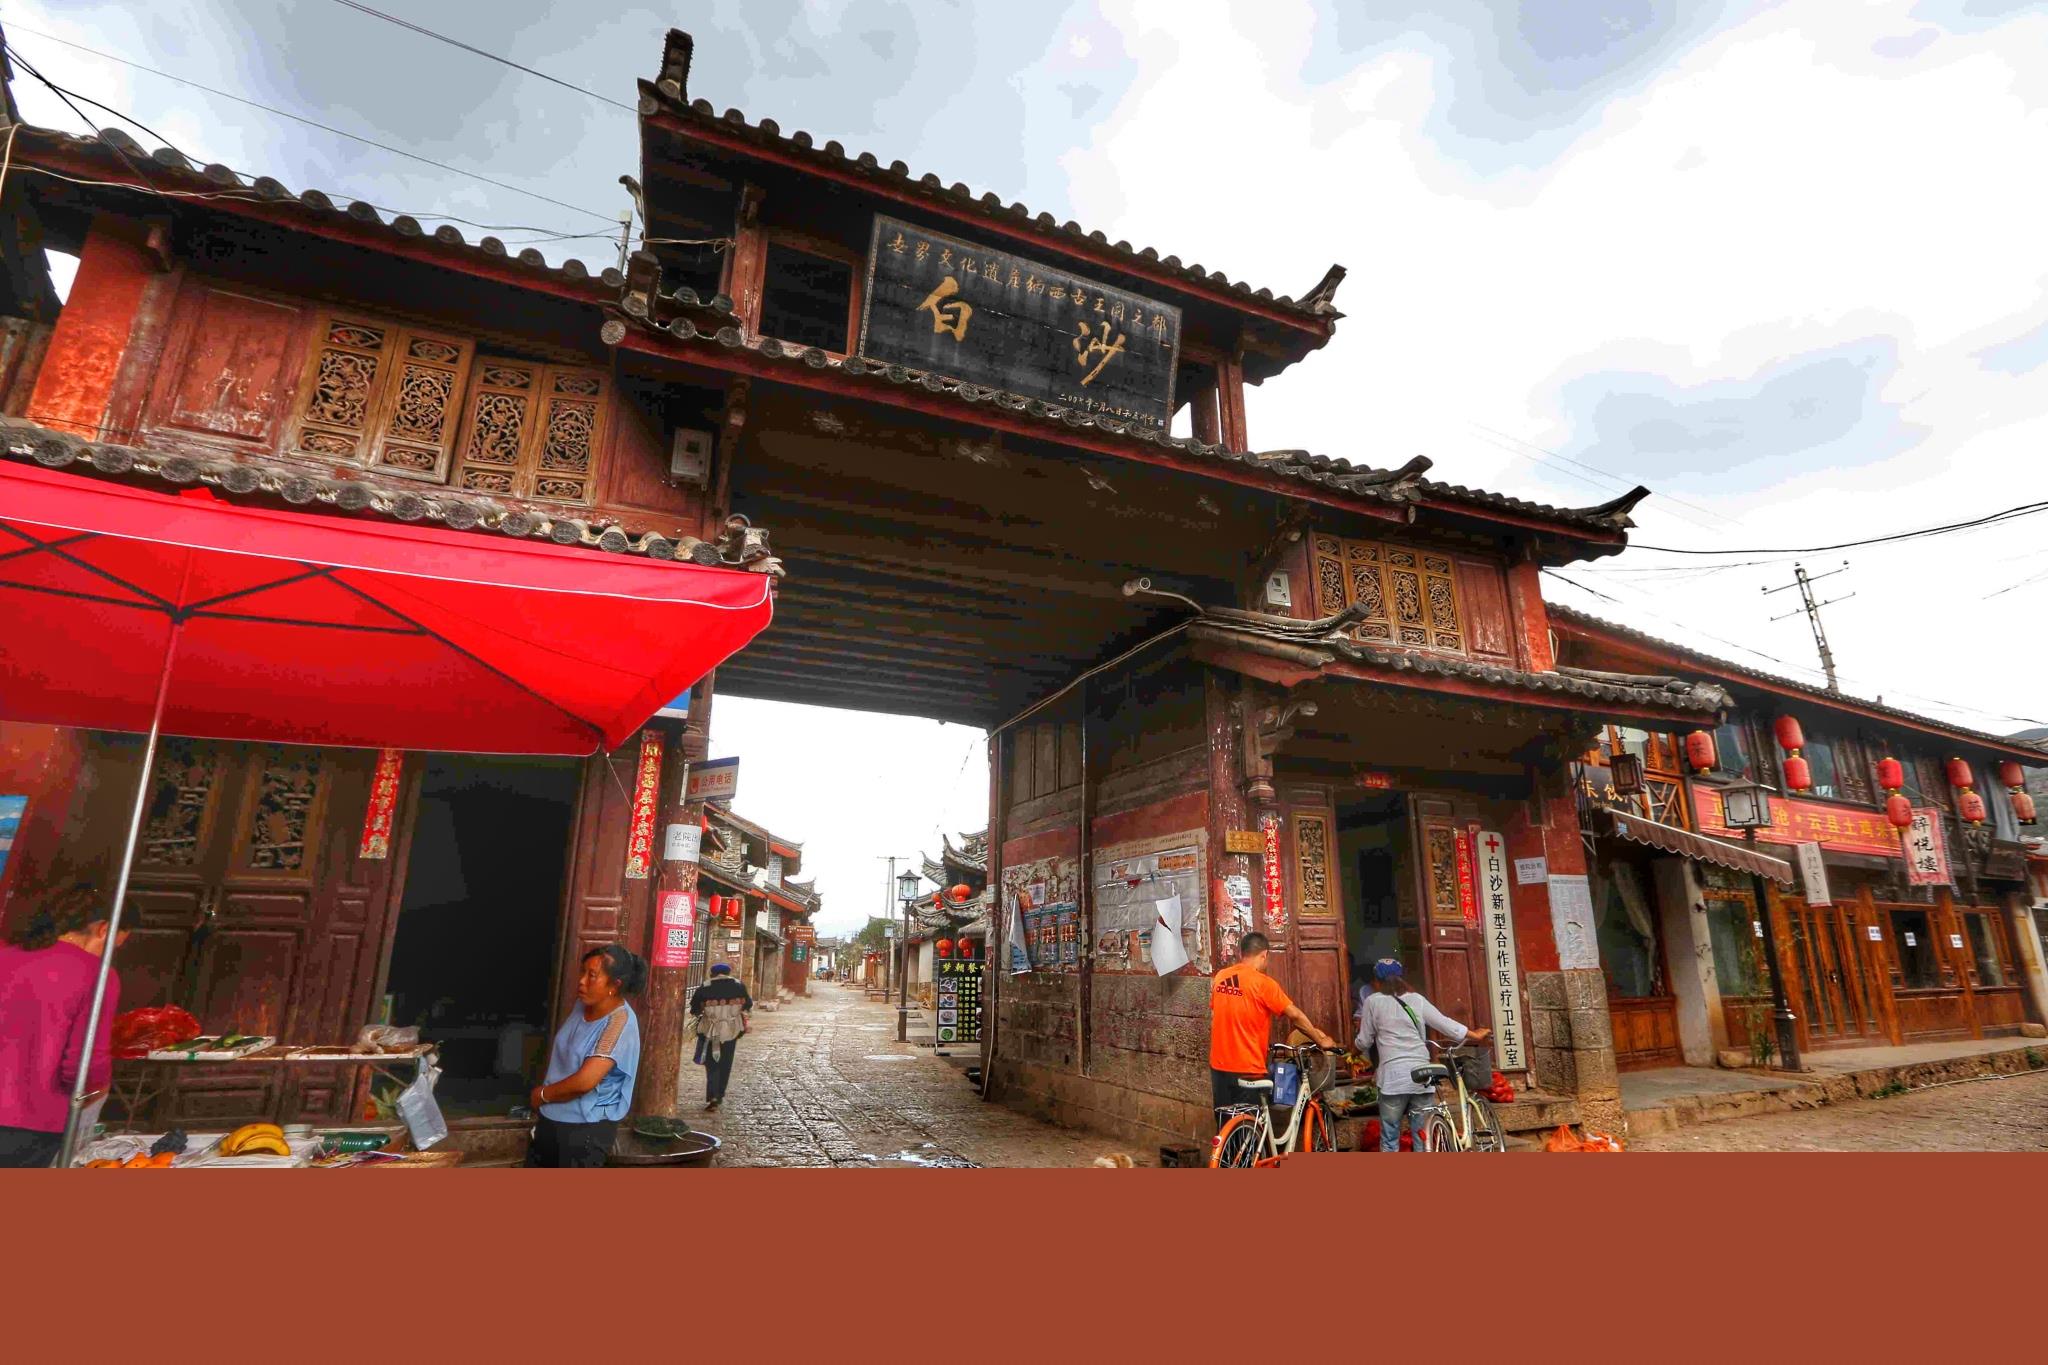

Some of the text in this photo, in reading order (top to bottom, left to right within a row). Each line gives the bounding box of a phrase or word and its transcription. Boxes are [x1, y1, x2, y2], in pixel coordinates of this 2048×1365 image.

[916, 276, 1126, 388] 白沙
[702, 772, 733, 787] 公用电话
[1216, 986, 1243, 997] adidas
[1489, 856, 1519, 1066] 白沙新型合作医疗卫生室
